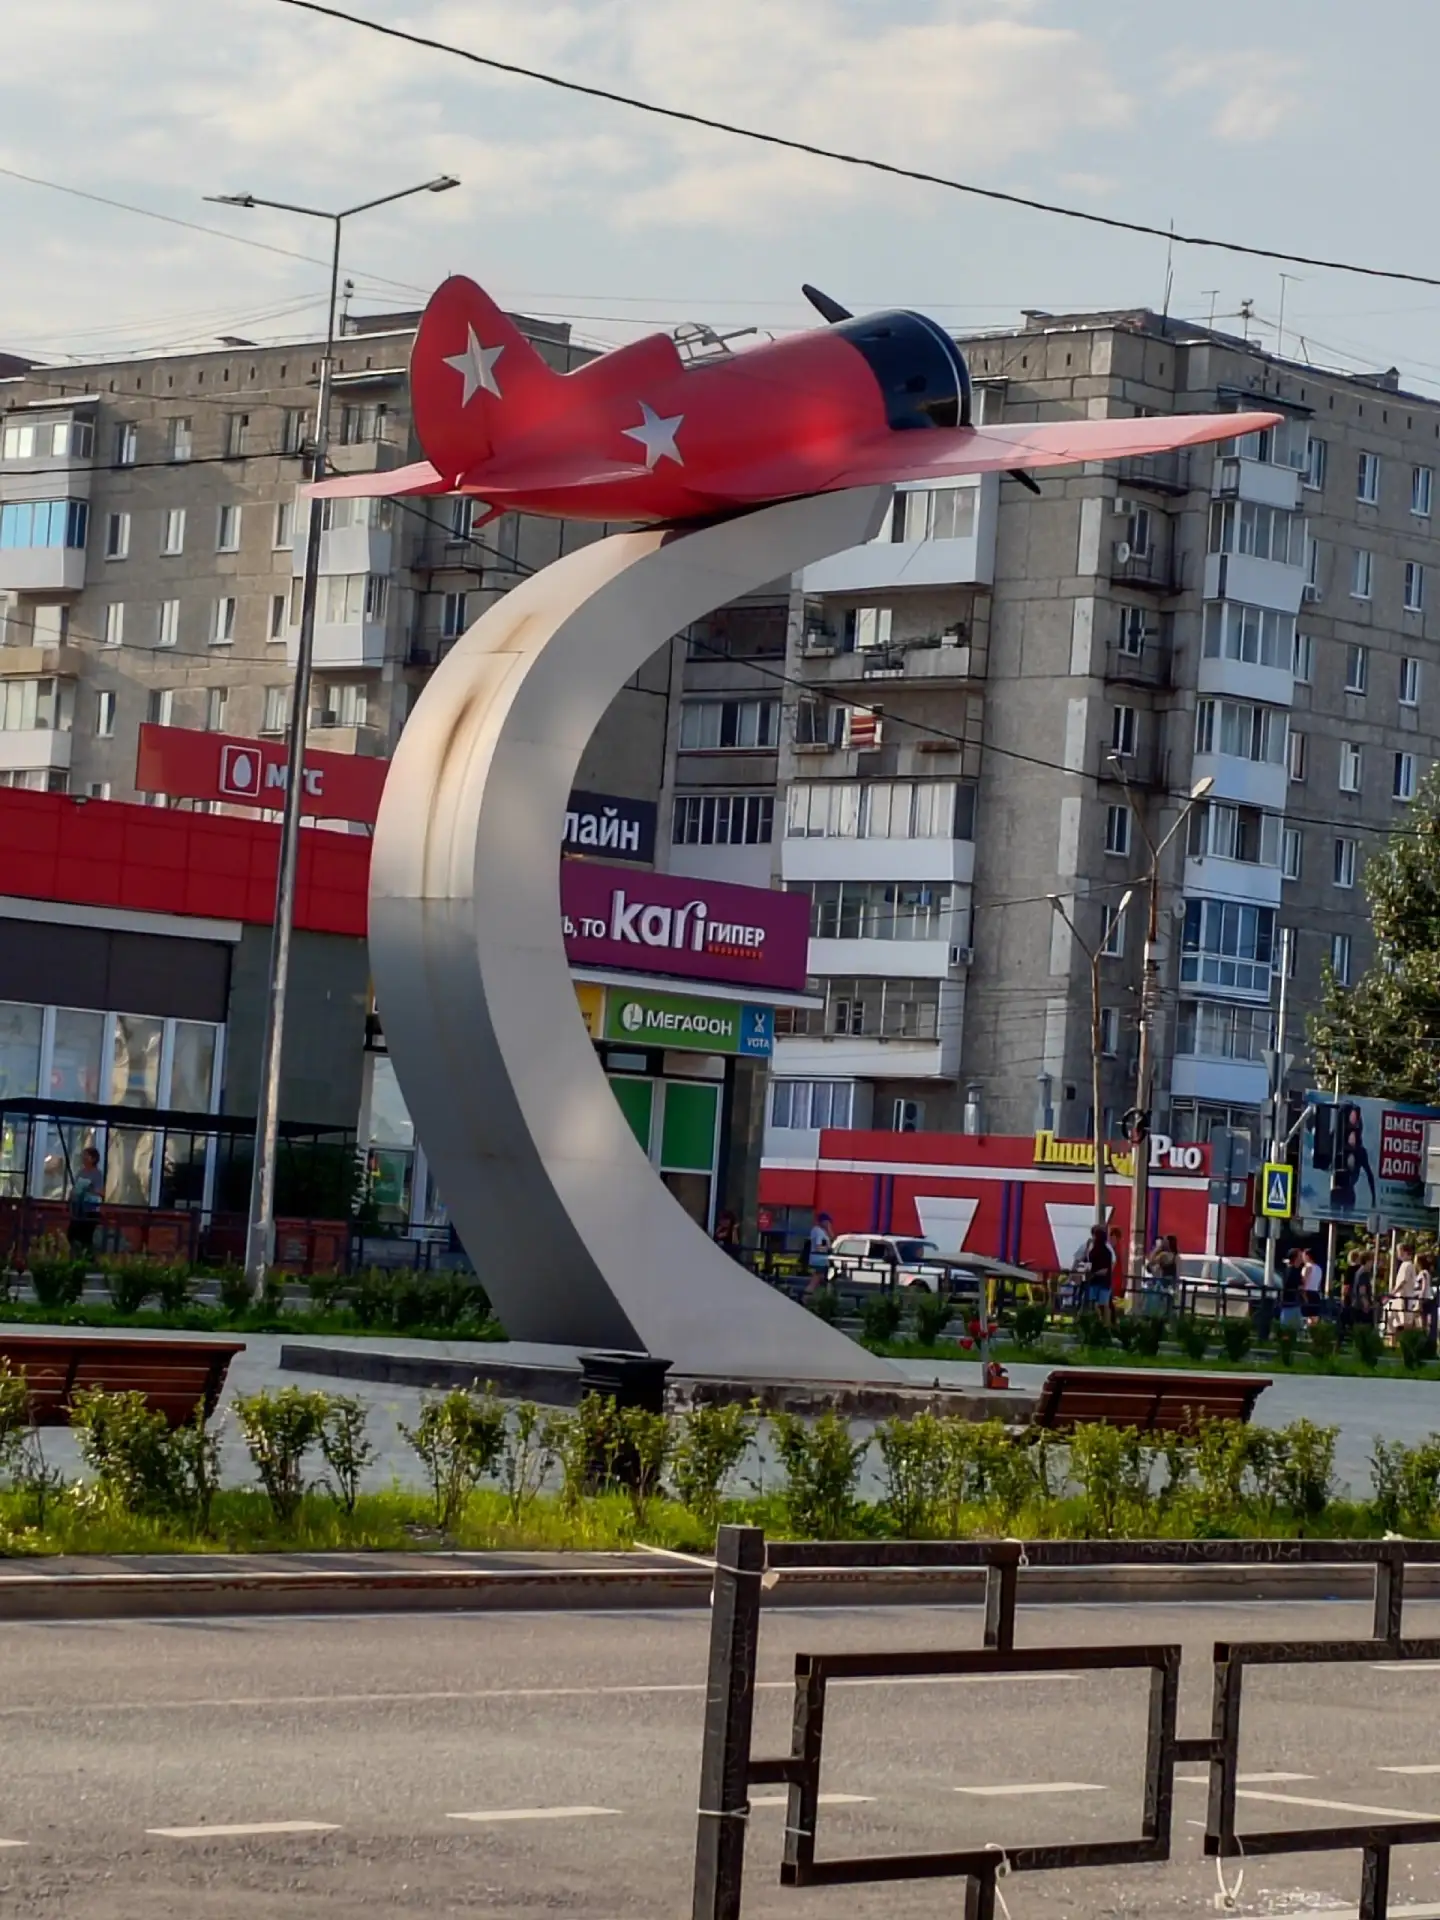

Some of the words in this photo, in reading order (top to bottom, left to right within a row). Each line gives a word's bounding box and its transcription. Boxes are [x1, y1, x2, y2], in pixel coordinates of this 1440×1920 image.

[265, 763, 324, 796] МС
[562, 806, 640, 851] лайн
[611, 890, 707, 951] kari
[708, 921, 765, 948] ГИПЕР
[1384, 1115, 1424, 1134] ВМЕС
[1148, 1134, 1202, 1170] Рио
[1383, 1136, 1422, 1157] ПОБЕ
